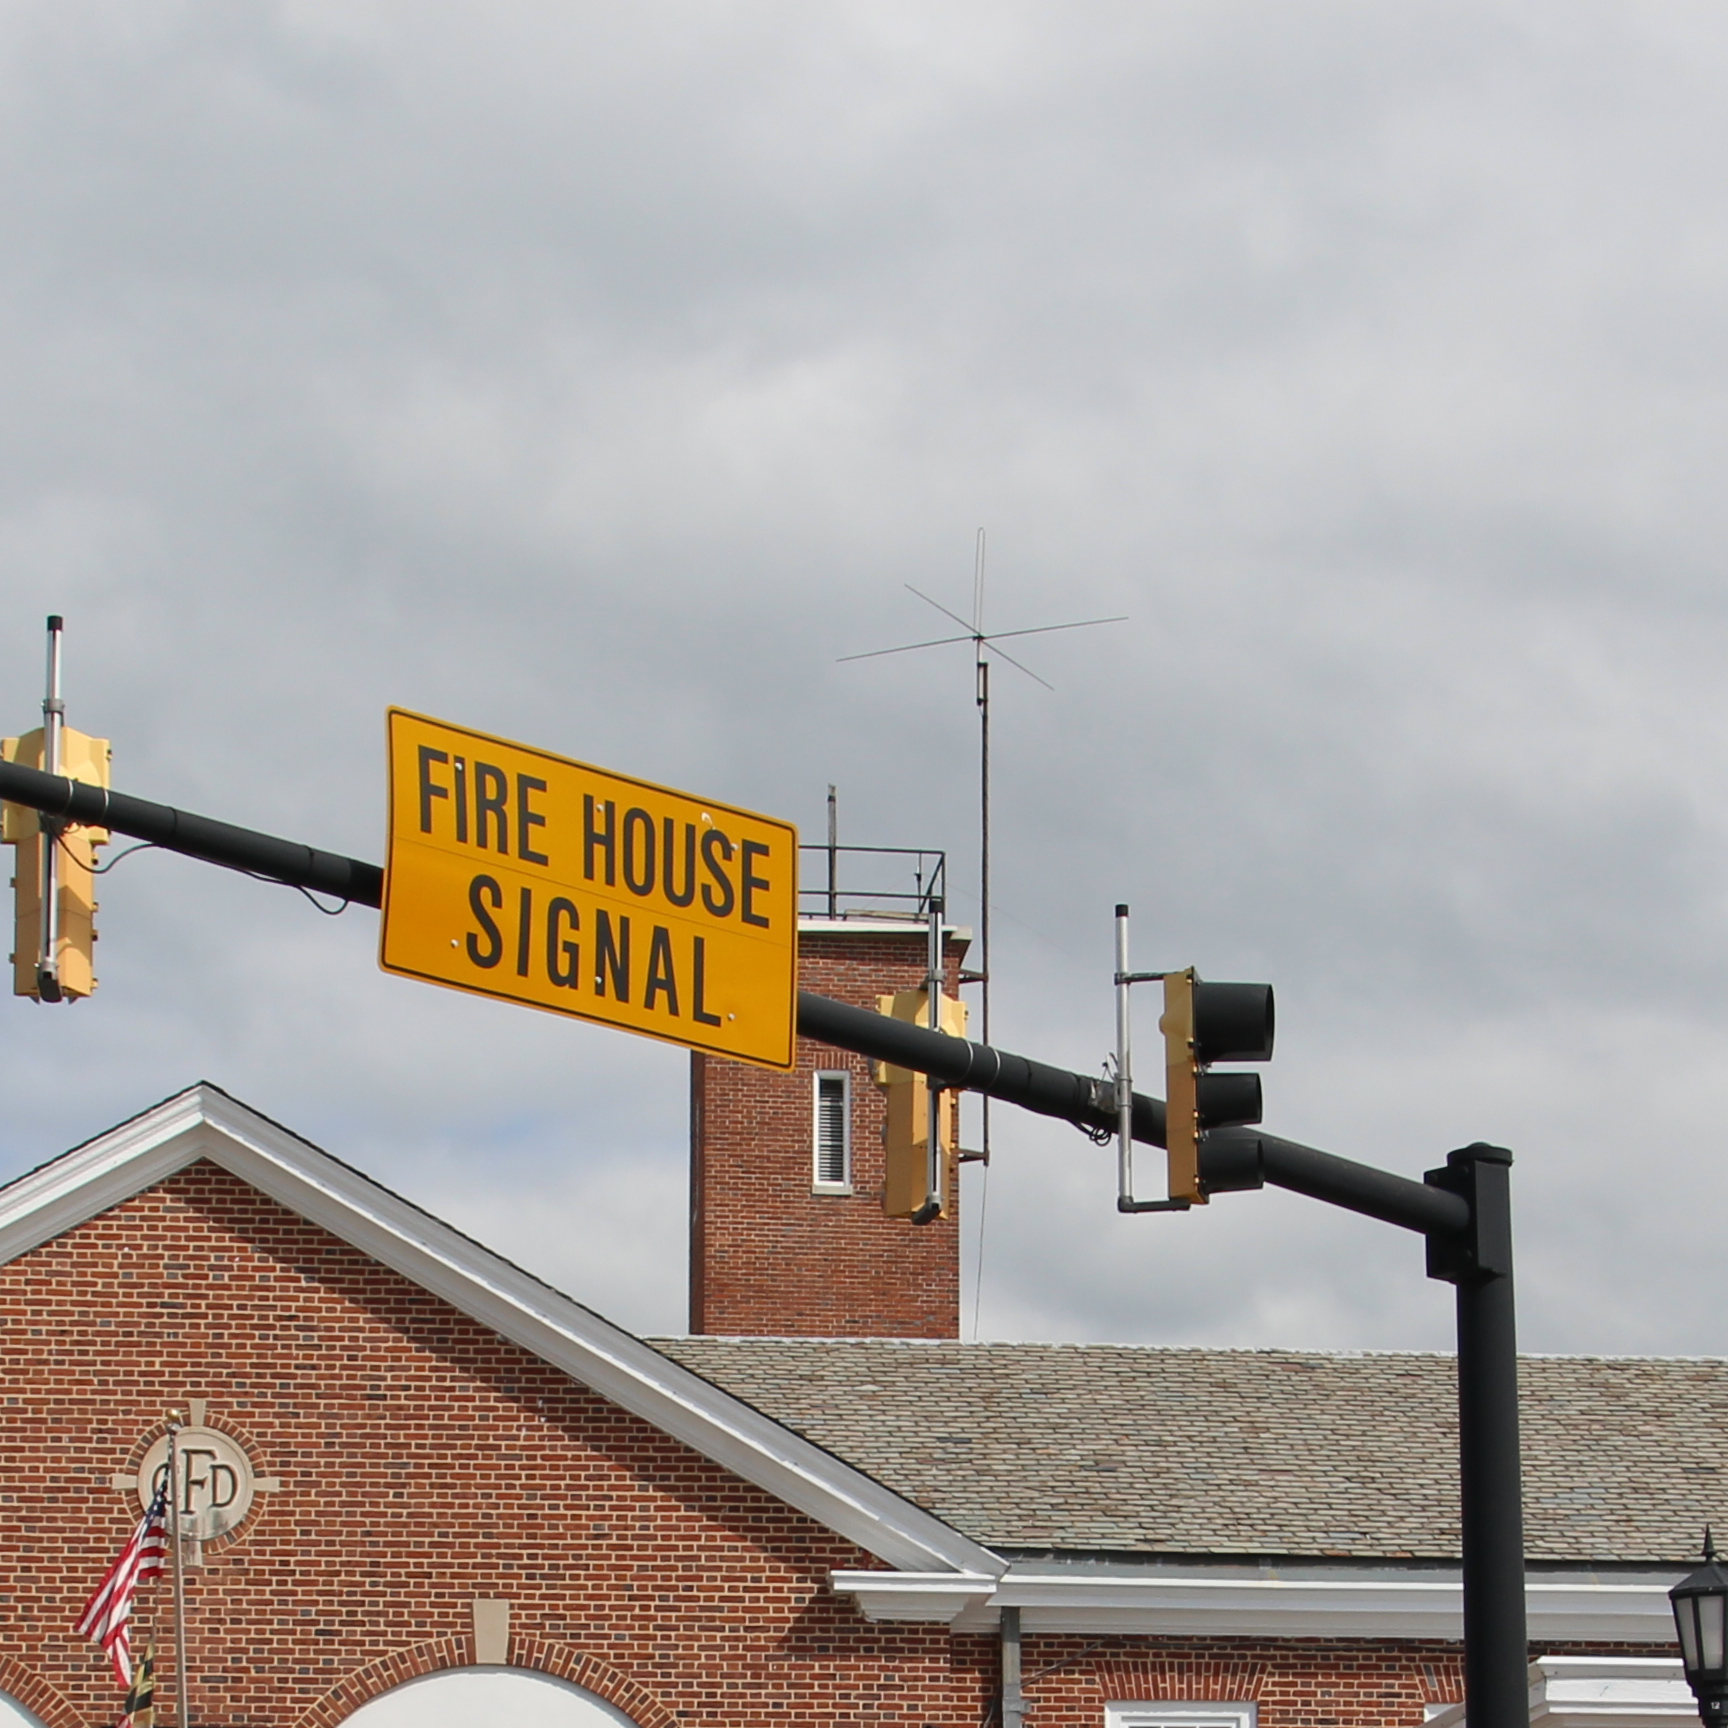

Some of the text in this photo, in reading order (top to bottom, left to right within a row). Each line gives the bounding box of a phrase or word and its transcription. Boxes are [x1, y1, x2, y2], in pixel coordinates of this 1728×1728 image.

[417, 744, 771, 929] FIRE HOUSE
[465, 874, 722, 1028] SIGNAL
